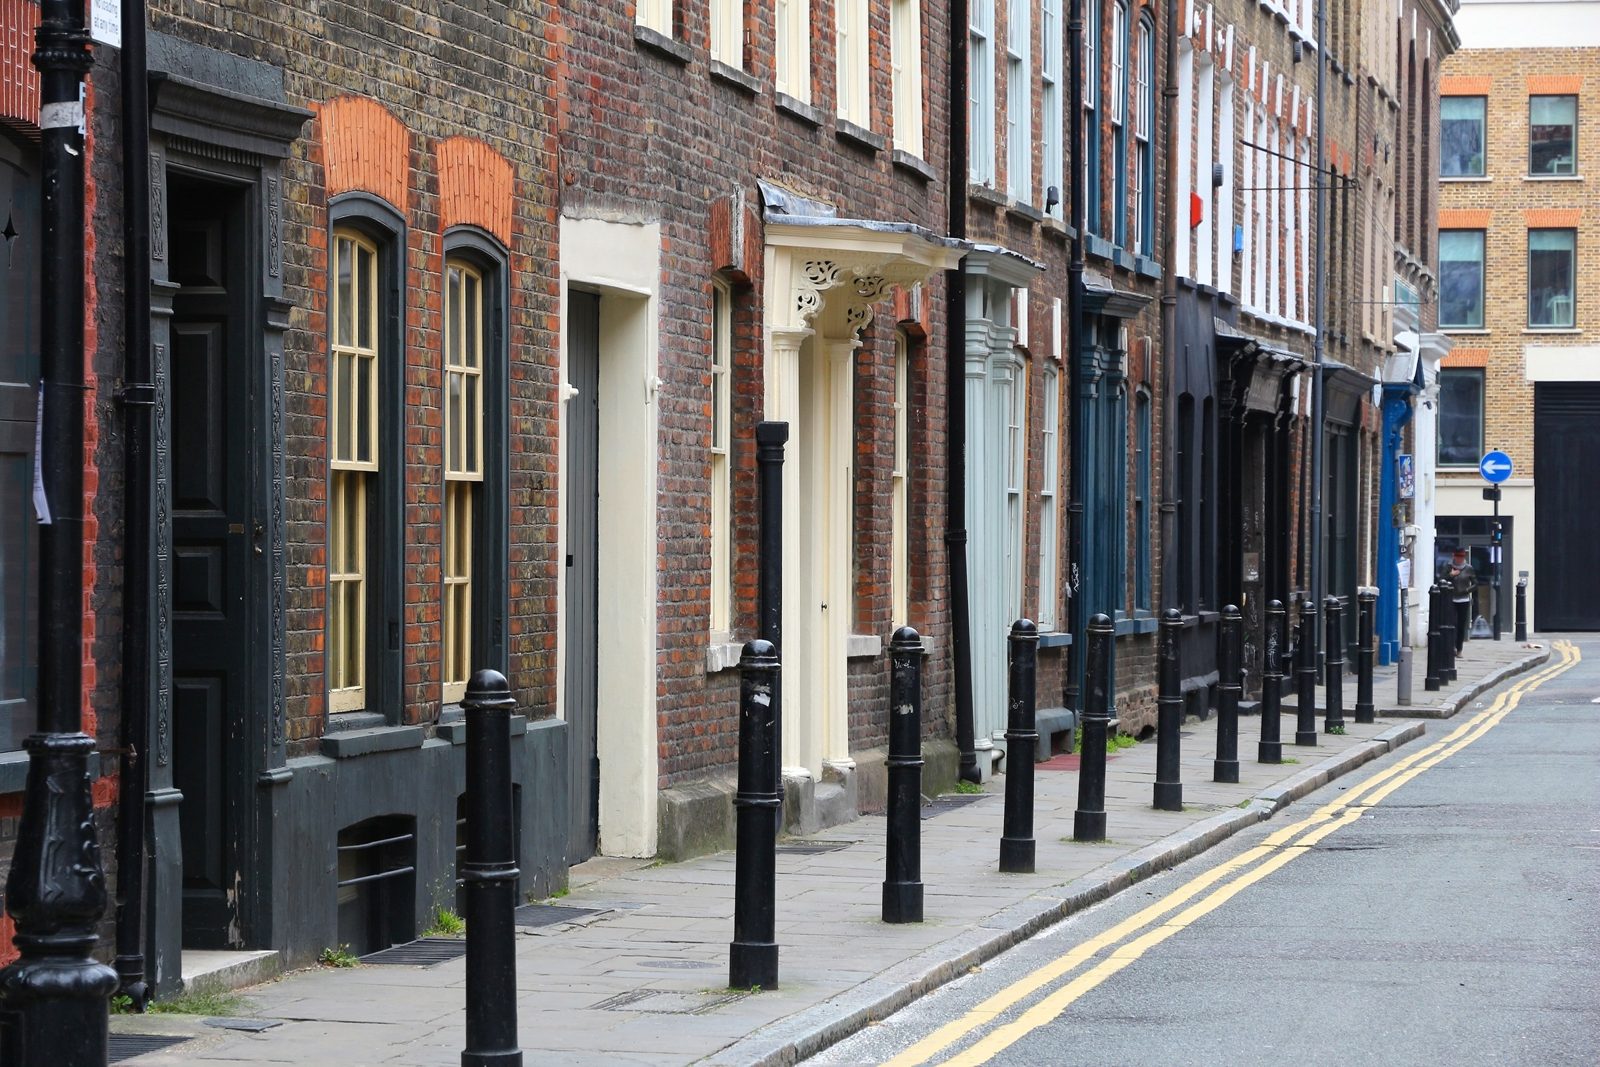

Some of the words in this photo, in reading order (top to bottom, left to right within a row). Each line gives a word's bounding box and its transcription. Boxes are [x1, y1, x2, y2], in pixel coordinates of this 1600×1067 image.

[102, 0, 118, 18] loading
[94, 14, 99, 28] at
[100, 19, 108, 34] any
[108, 20, 118, 35] time
